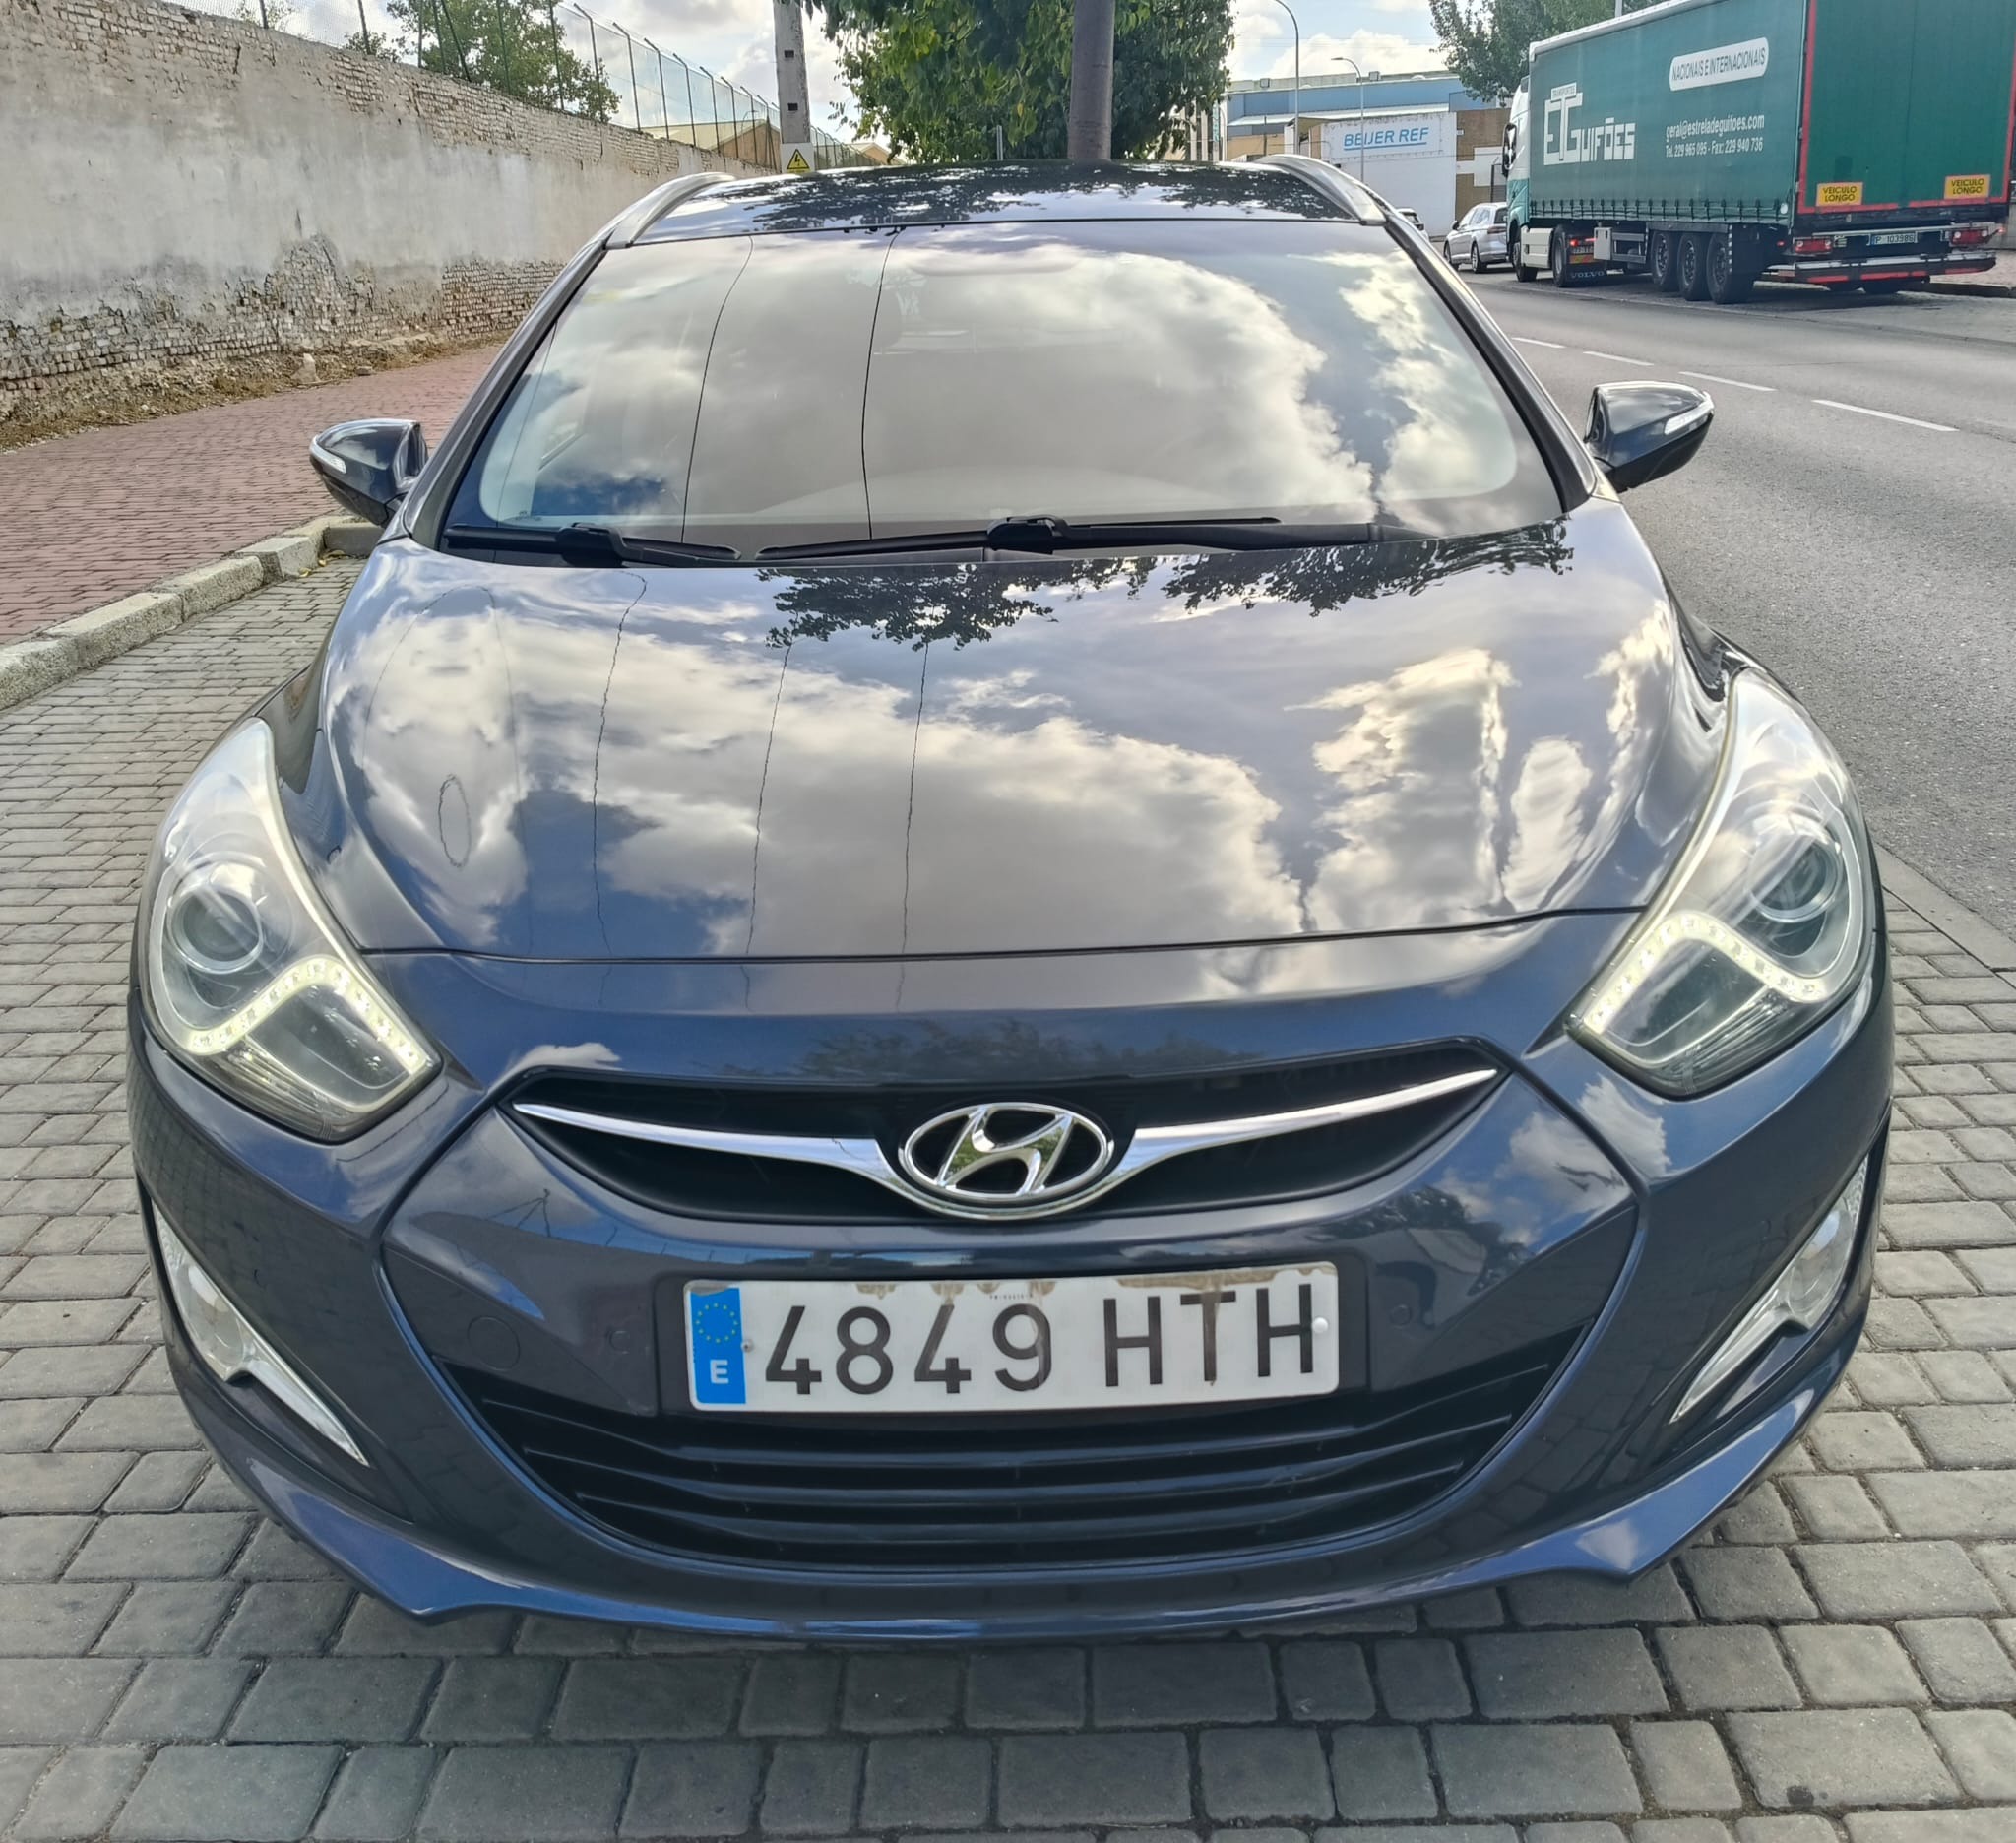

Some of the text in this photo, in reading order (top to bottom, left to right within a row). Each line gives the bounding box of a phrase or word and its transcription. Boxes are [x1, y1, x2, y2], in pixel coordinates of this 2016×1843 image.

[1672, 47, 1766, 81] NACIONAIS E INTERNACIONAIS
[1344, 127, 1429, 147] BEIJER REF
[1666, 114, 1765, 142] geral@estreladeguifoes.com
[1725, 139, 1736, 153] 229
[1737, 138, 1749, 152] 940
[1751, 137, 1763, 152] 736
[1951, 178, 1984, 187] VEICULO
[1952, 186, 1983, 195] LONGO
[1570, 270, 1605, 279] VOLVO
[765, 1284, 1313, 1395] 4849 HTH
[710, 1360, 729, 1385] E
